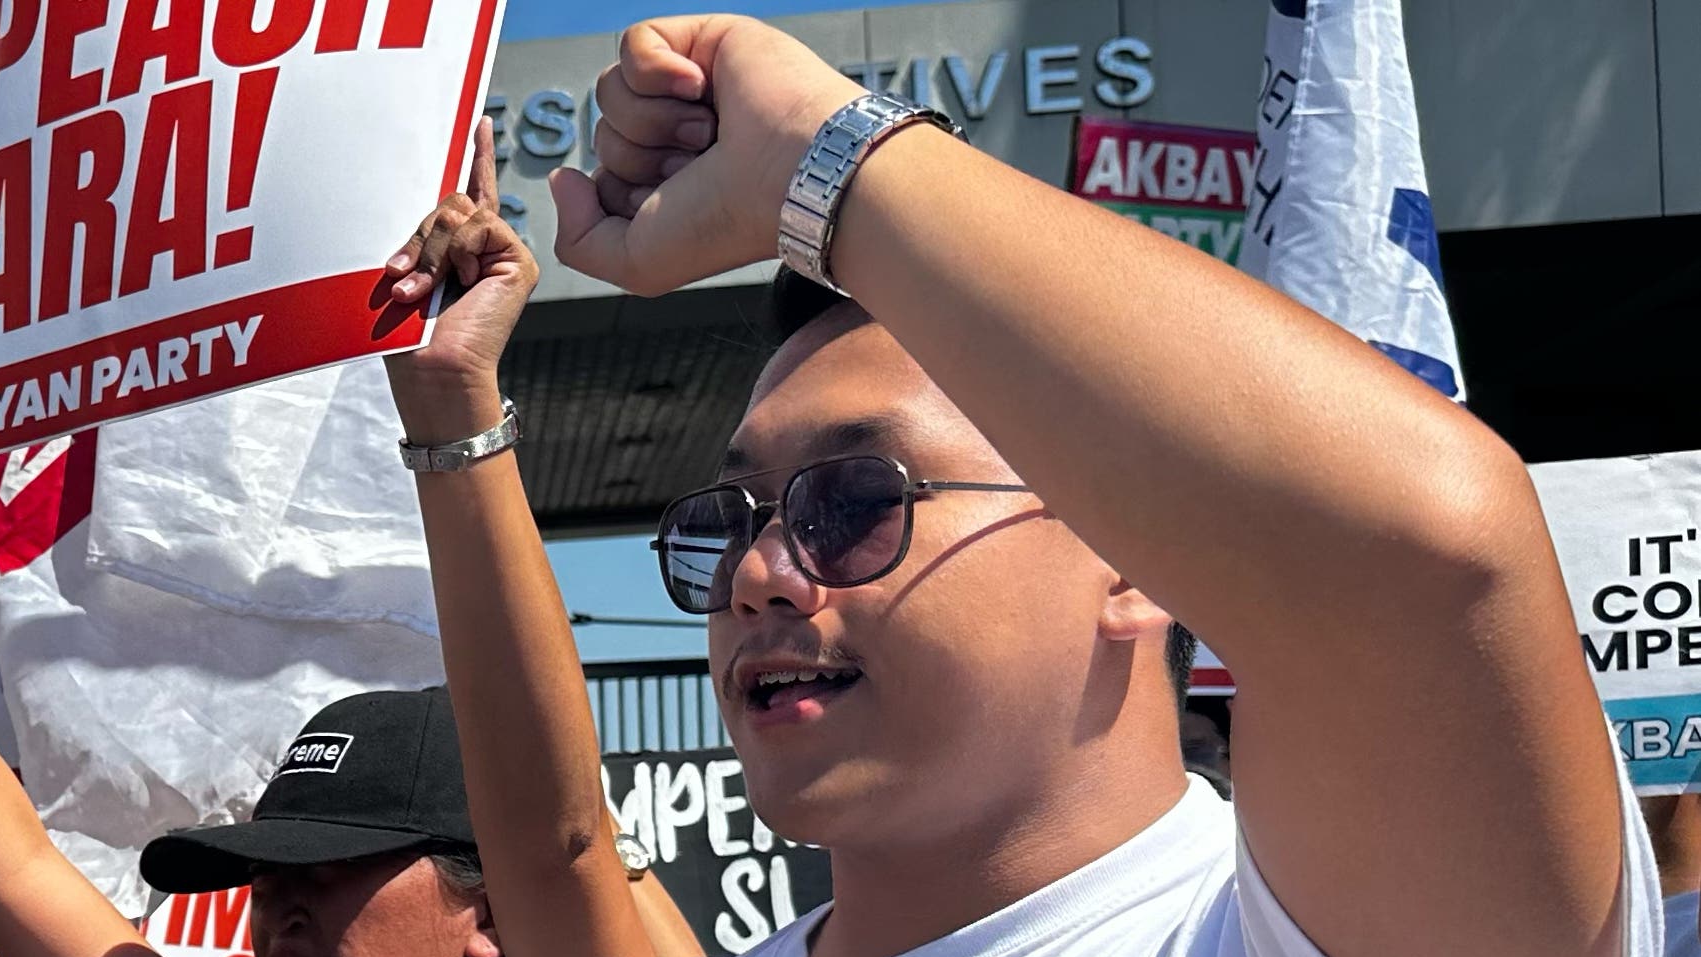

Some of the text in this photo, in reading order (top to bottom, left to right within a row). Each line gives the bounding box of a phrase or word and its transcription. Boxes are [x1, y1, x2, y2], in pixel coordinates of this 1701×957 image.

[1082, 136, 1259, 207] AKBAY
[91, 314, 264, 405] PARTY
[283, 743, 340, 762] reme
